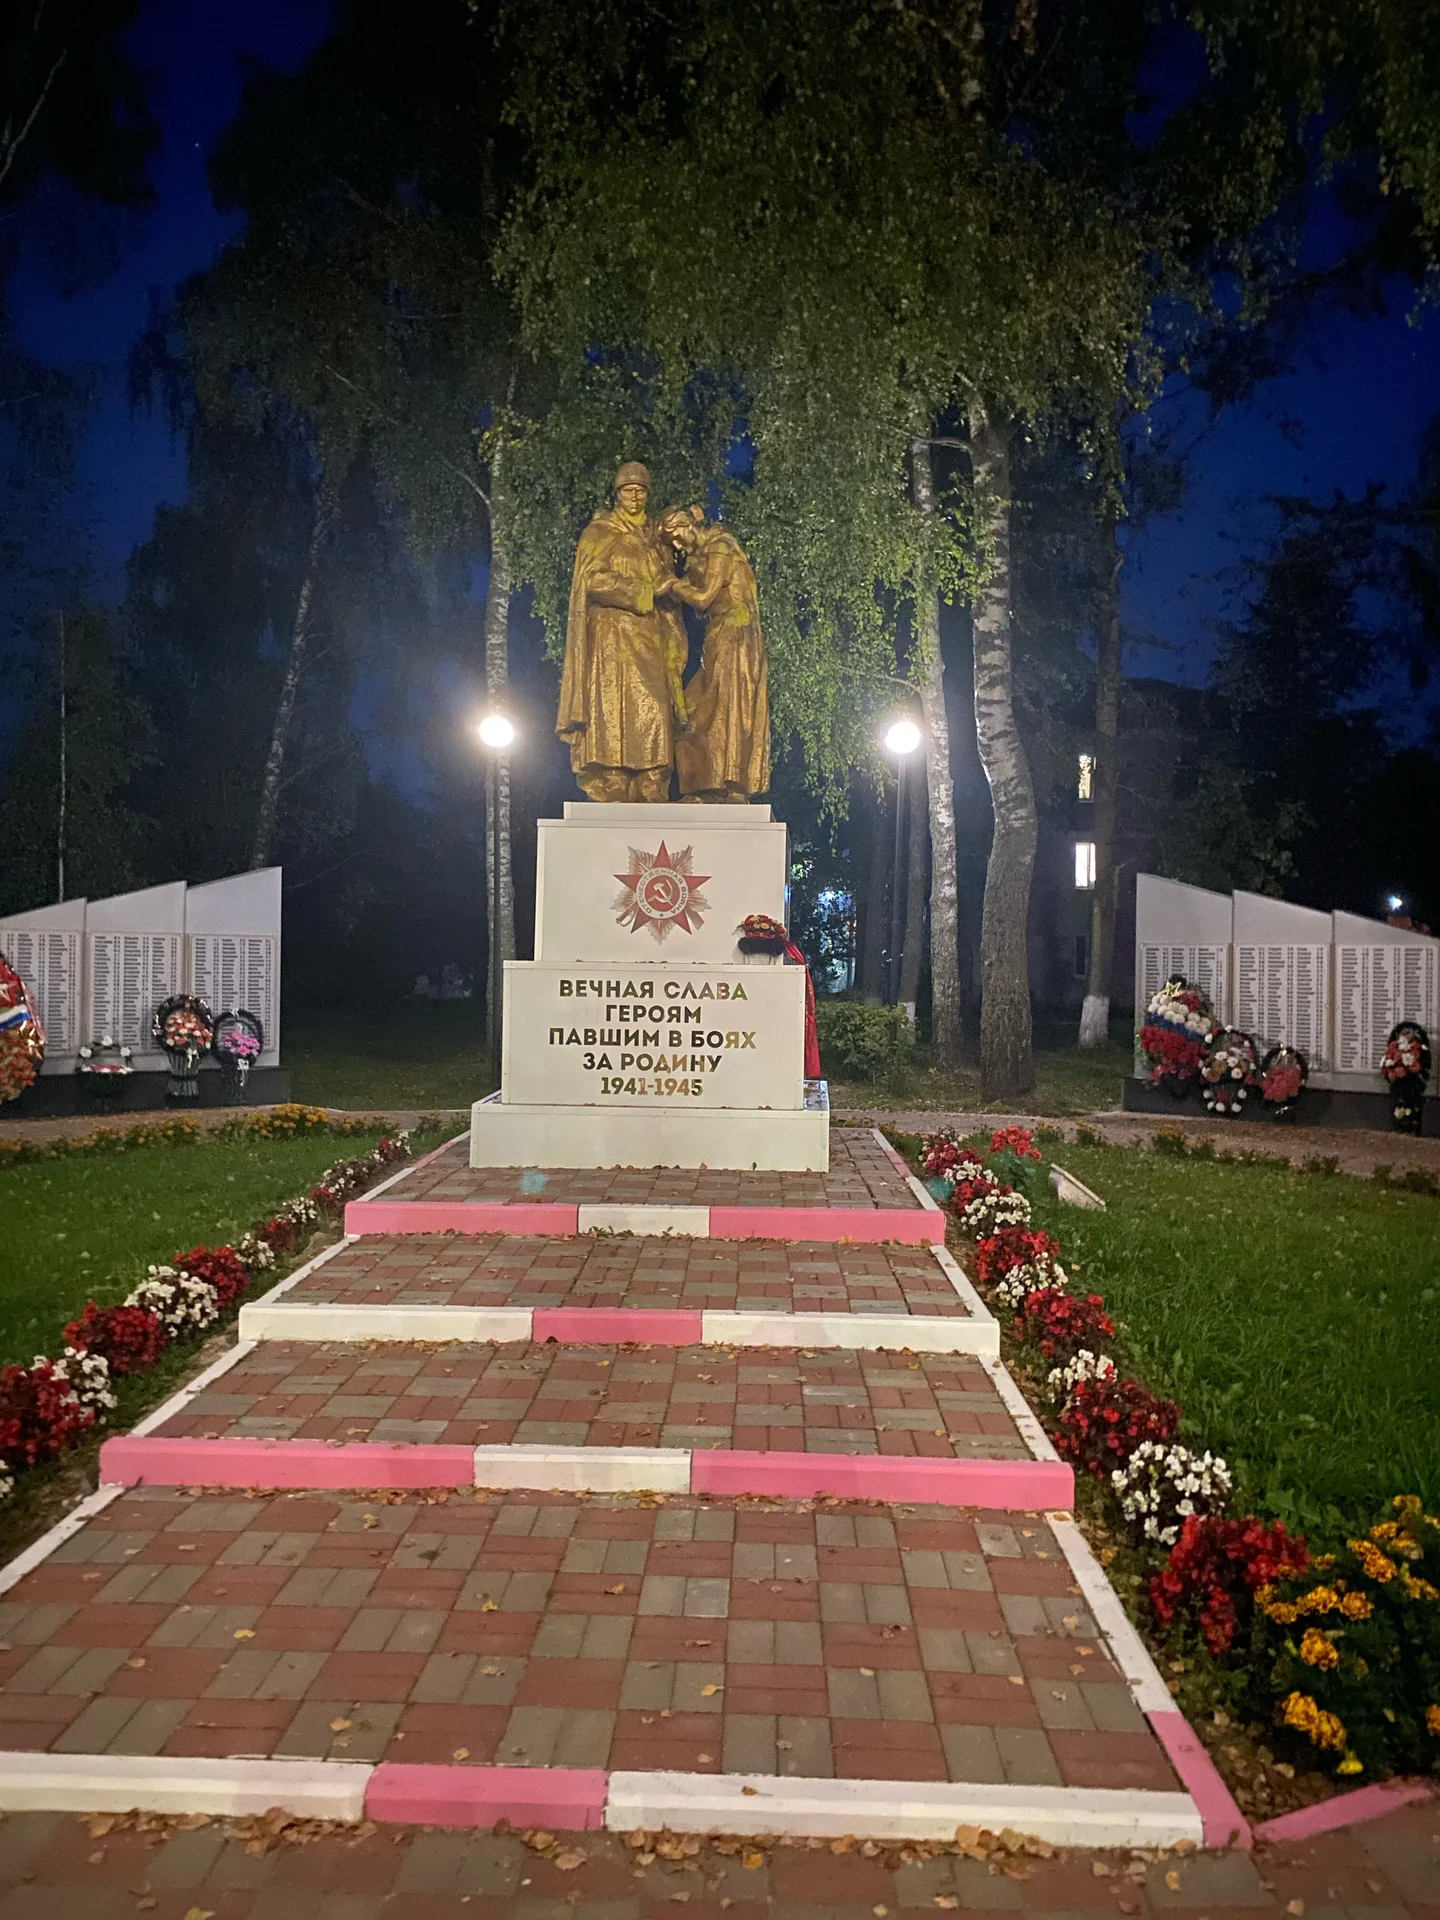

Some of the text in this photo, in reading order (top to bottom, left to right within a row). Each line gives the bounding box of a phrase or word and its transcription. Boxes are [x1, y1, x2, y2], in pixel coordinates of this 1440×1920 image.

[638, 869, 684, 914] ОТЕЧЕСТВЕННАЯ
[559, 980, 748, 1000] ВЕЧНАЯ СЛАВА
[606, 1005, 702, 1023] ГЕРОЯМ
[549, 1028, 757, 1049] ПАВШИМ В БОЯХ
[582, 1052, 722, 1073] ЗА РОДИНУ
[600, 1076, 703, 1096] 1941-1945
